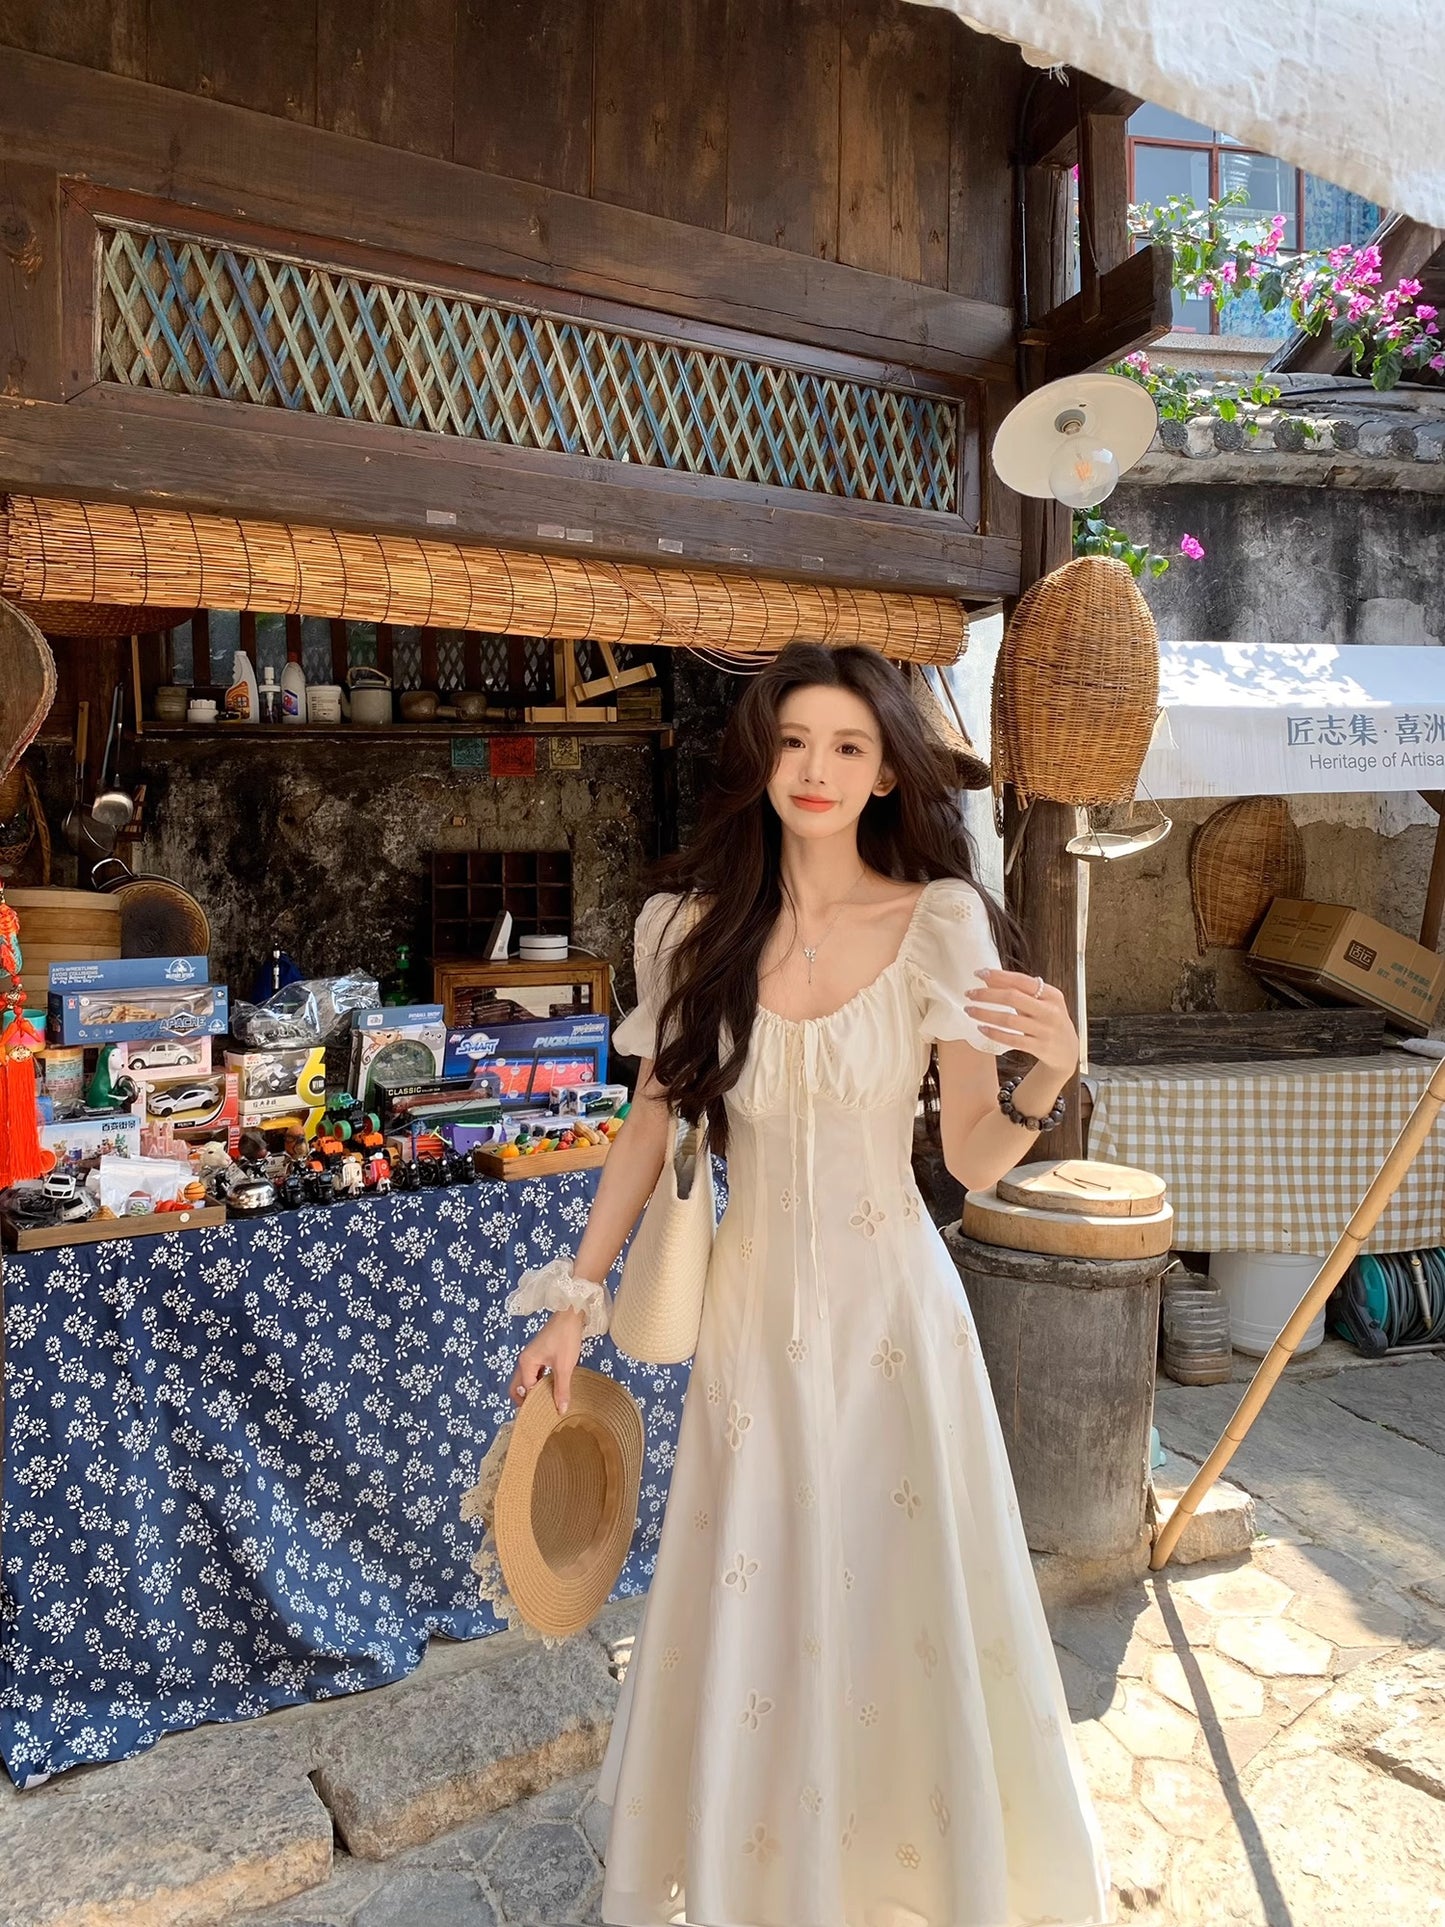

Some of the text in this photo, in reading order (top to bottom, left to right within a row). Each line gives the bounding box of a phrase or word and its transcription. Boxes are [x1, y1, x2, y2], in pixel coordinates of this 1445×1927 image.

[1309, 753, 1377, 772] Heritage
[1382, 752, 1397, 767] of
[159, 1015, 207, 1030] APACHE
[455, 1037, 500, 1055] SMART
[388, 1086, 422, 1096] CLASSIC
